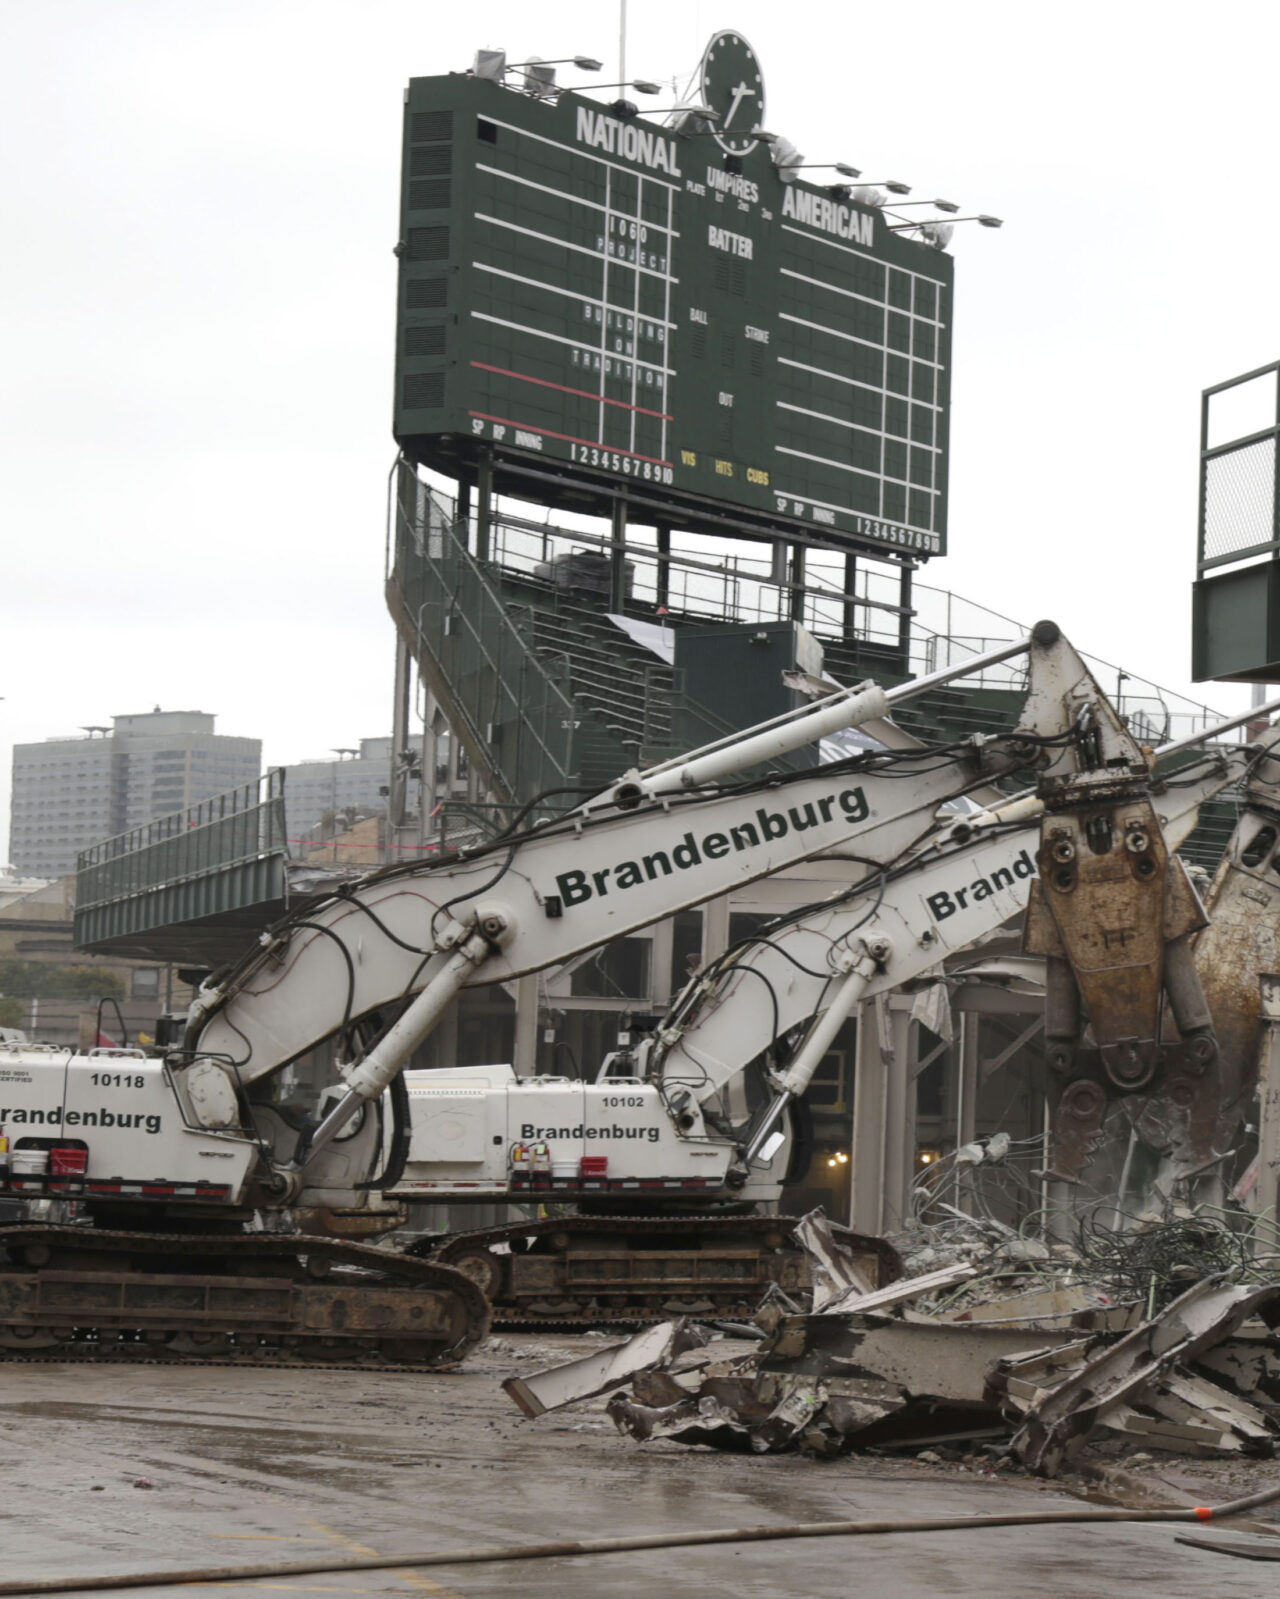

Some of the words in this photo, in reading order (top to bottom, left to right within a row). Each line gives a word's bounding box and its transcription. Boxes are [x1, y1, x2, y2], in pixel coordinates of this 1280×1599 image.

[576, 106, 682, 177] NATIONAL
[686, 180, 706, 196] PLATE
[706, 166, 759, 203] UMPIRES
[610, 216, 647, 243] 1060
[781, 185, 874, 247] AMERICAN
[597, 238, 666, 272] PROJECT
[708, 224, 753, 260] BATTER
[585, 305, 664, 341] BUILDING
[690, 307, 708, 325] BALL
[745, 325, 769, 344] STRIKE
[573, 350, 663, 387] TRADITION
[719, 392, 734, 407] OUT
[472, 418, 484, 435] SP
[681, 450, 696, 467] VIS
[715, 460, 733, 477] HITS
[746, 467, 769, 486] CUBS
[777, 497, 787, 512] SP
[556, 785, 870, 908] Brandenburg
[926, 849, 1040, 922] Brand
[91, 1073, 145, 1089] 10118
[602, 1096, 644, 1108] 10102
[0, 1106, 162, 1135] randenburg
[521, 1124, 660, 1143] Brandenburg
